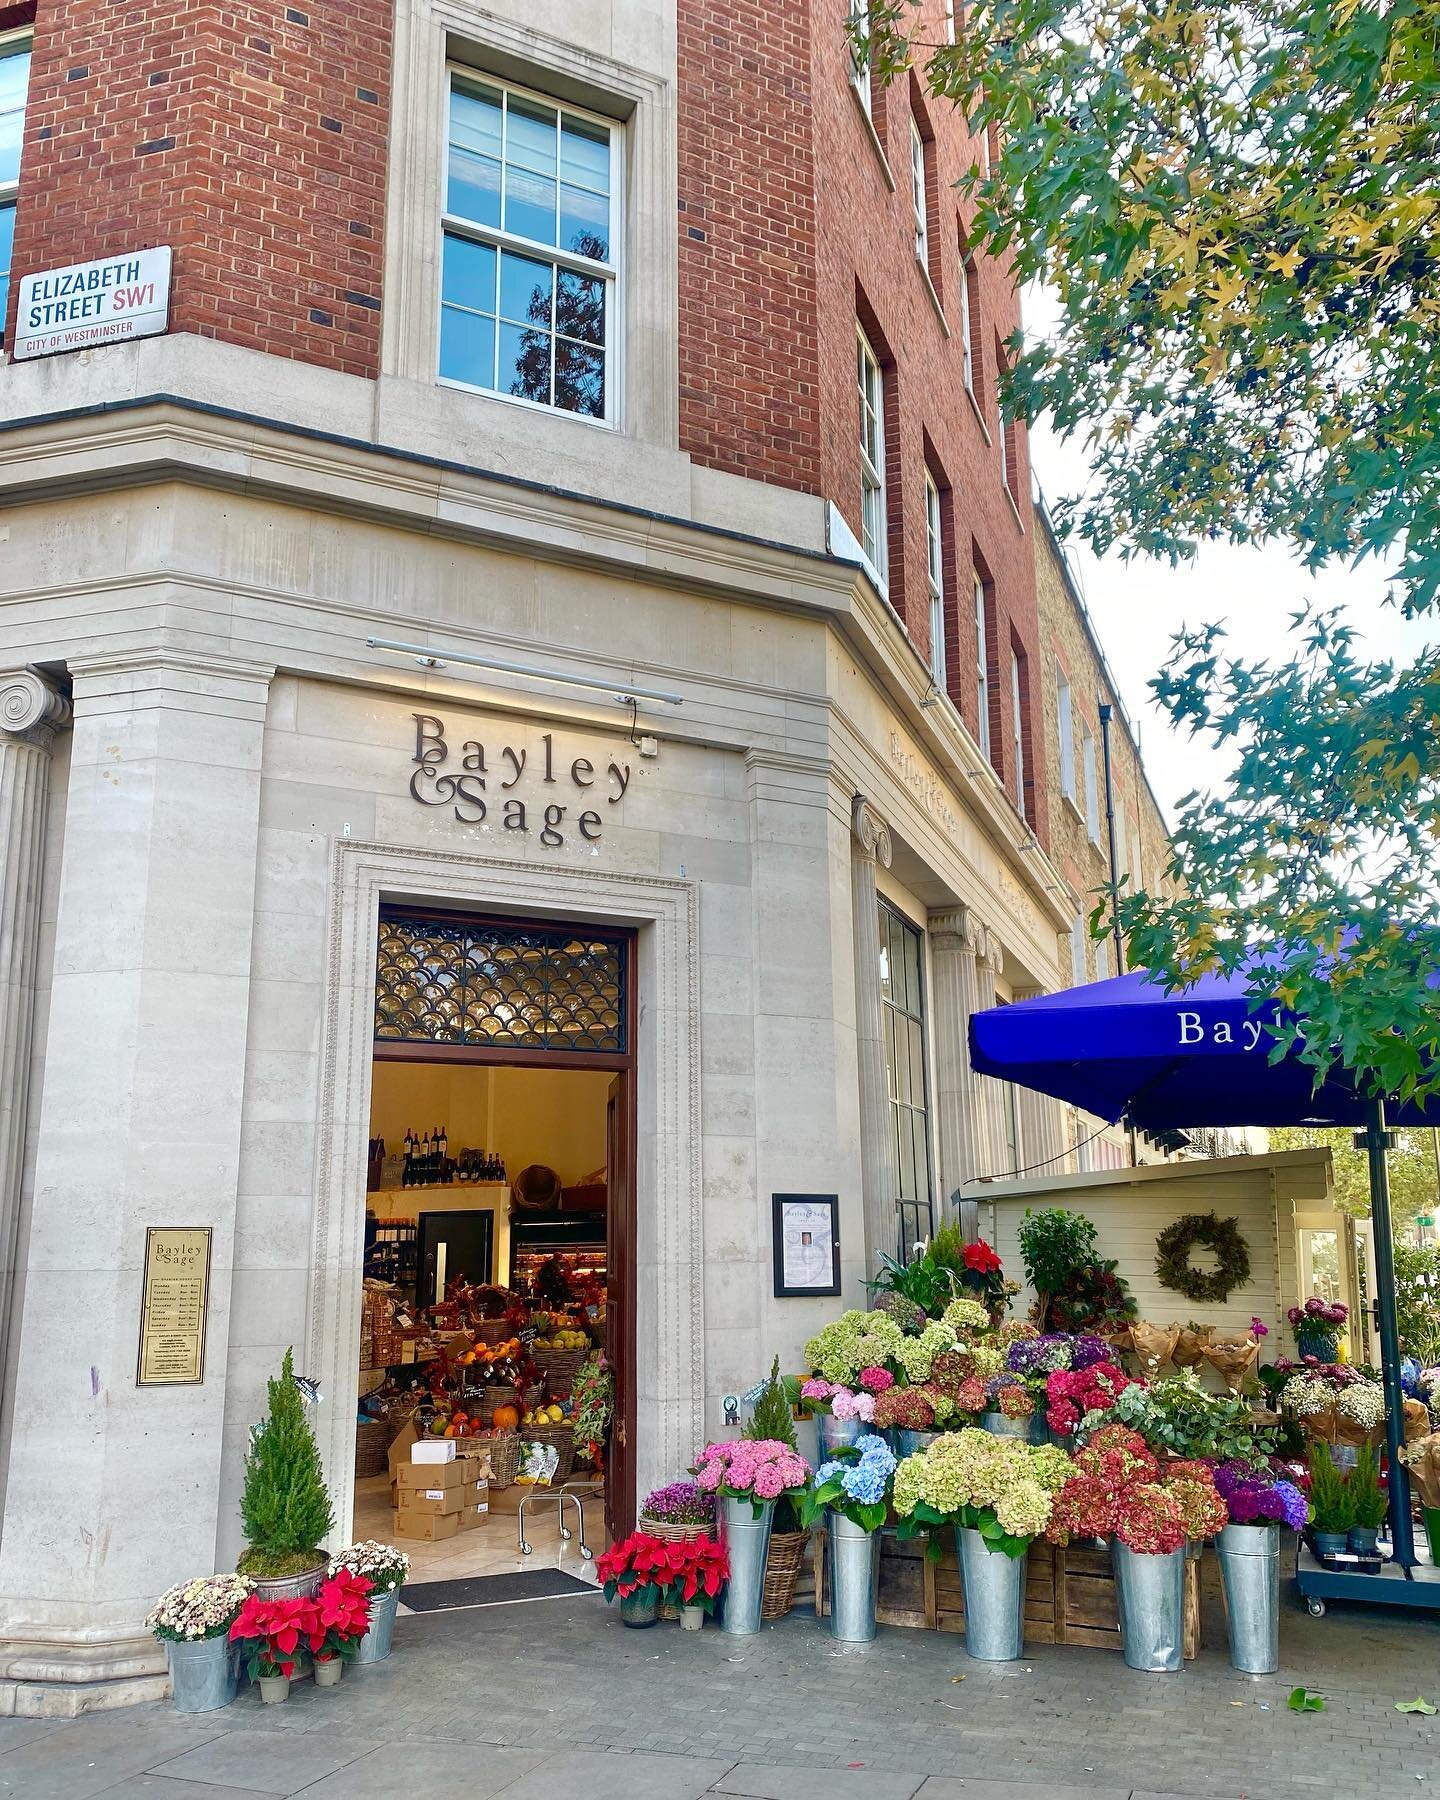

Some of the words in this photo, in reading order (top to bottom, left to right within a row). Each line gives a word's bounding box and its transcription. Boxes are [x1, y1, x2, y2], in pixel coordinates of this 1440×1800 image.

[31, 260, 140, 302] ELIZABETH
[29, 293, 106, 328] STREET
[112, 283, 155, 311] SW1
[26, 338, 48, 351] CITY
[50, 336, 61, 347] OF
[65, 321, 133, 344] WESTMINSTER
[411, 712, 631, 804] Bayley
[155, 1243, 202, 1257] Bayley
